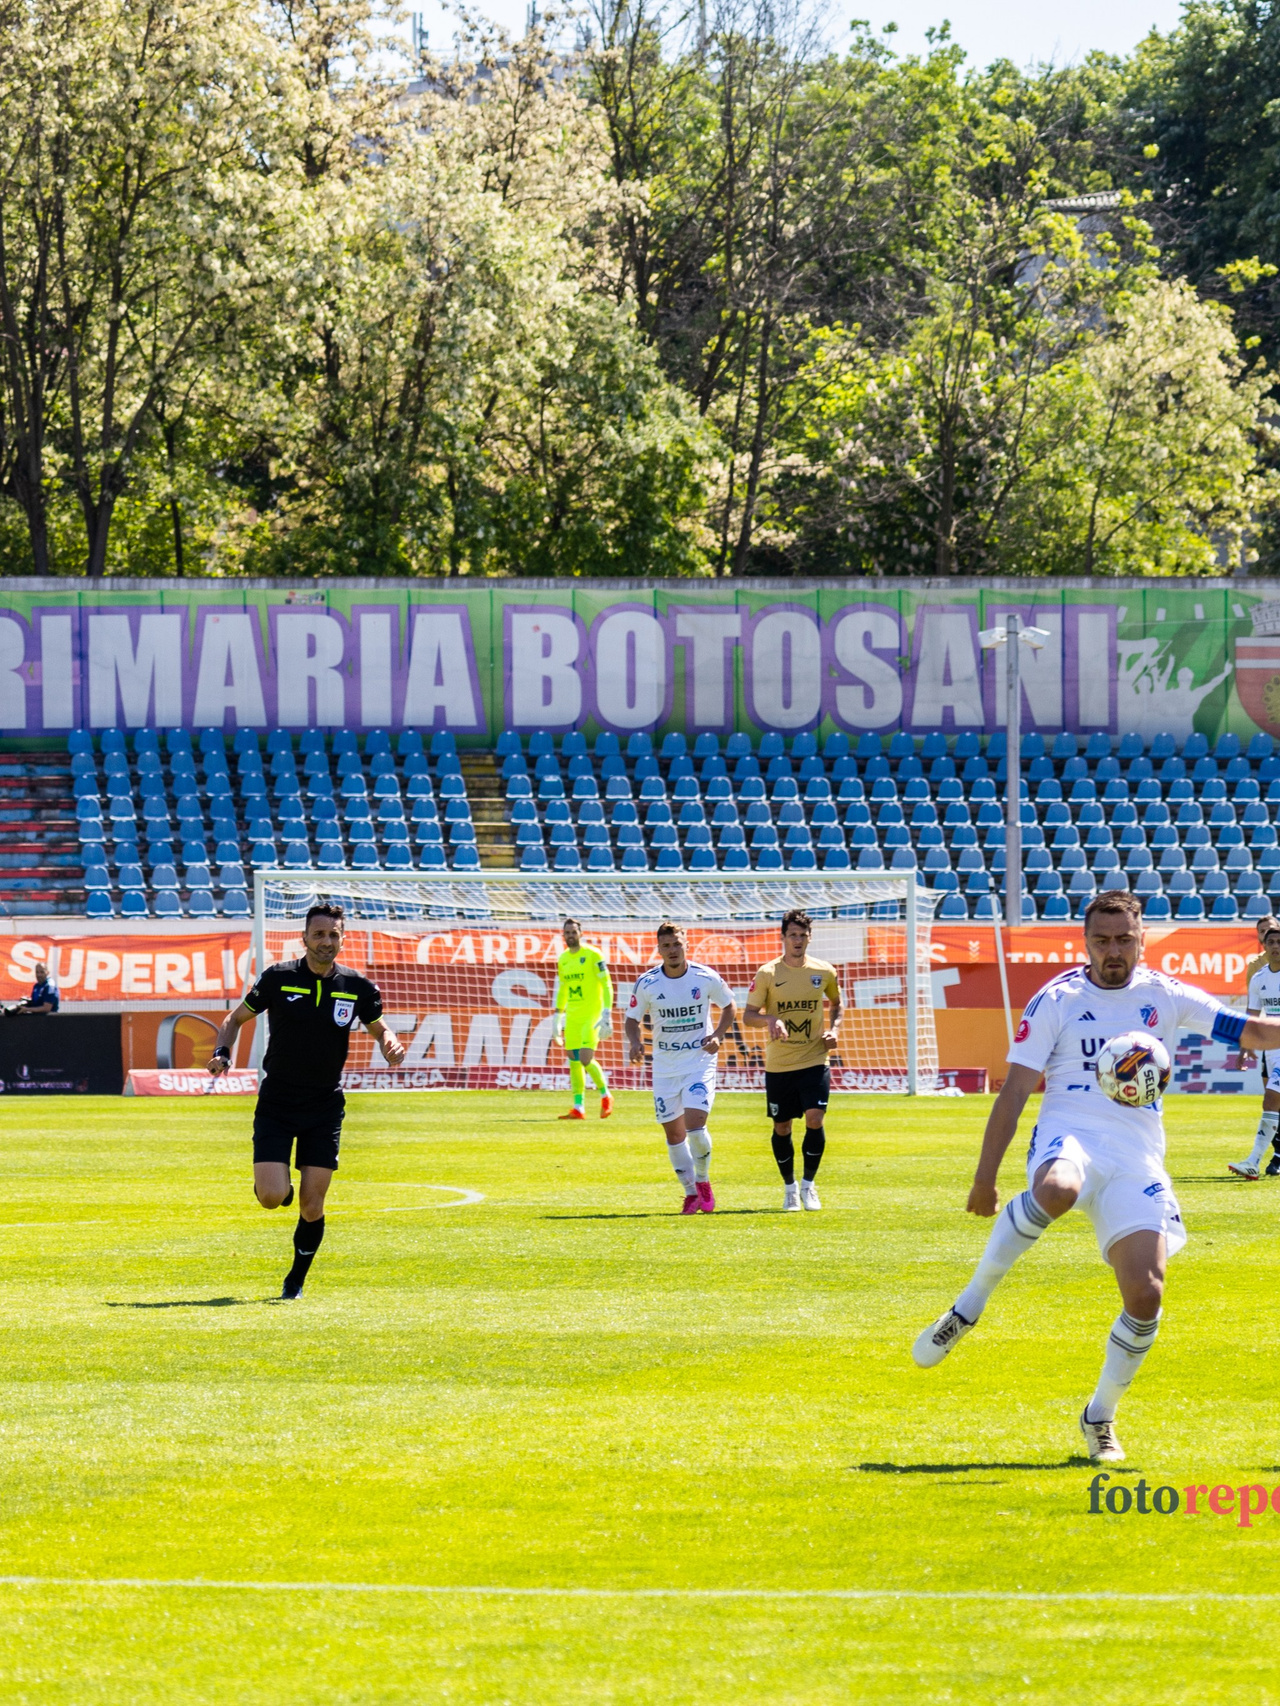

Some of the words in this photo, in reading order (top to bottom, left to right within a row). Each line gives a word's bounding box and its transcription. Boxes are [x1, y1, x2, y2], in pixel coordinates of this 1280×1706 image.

[511, 610, 1110, 729] BOTOSANI
[659, 1004, 703, 1018] UNIBET
[777, 1000, 818, 1012] MAXBET
[654, 1096, 666, 1113] 3
